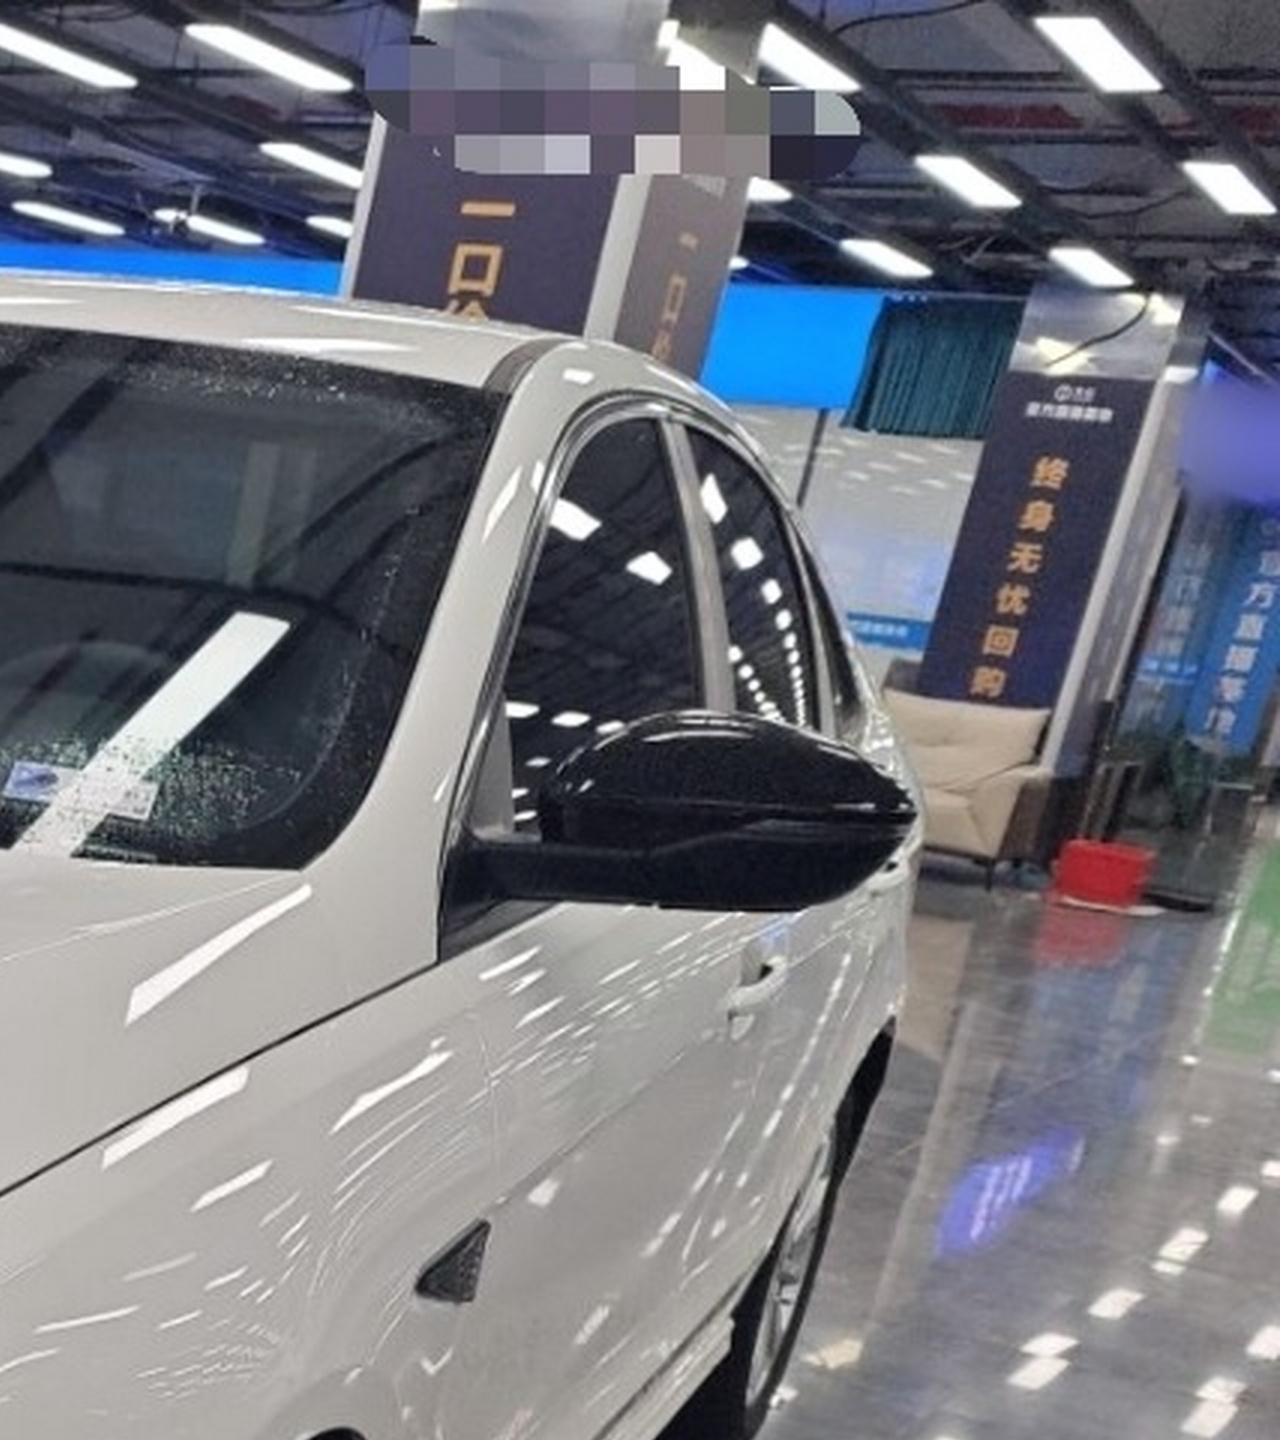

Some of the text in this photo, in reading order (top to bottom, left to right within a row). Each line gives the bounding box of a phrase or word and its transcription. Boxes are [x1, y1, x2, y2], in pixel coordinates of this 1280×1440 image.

[970, 456, 1070, 698] 终身无忧回购
